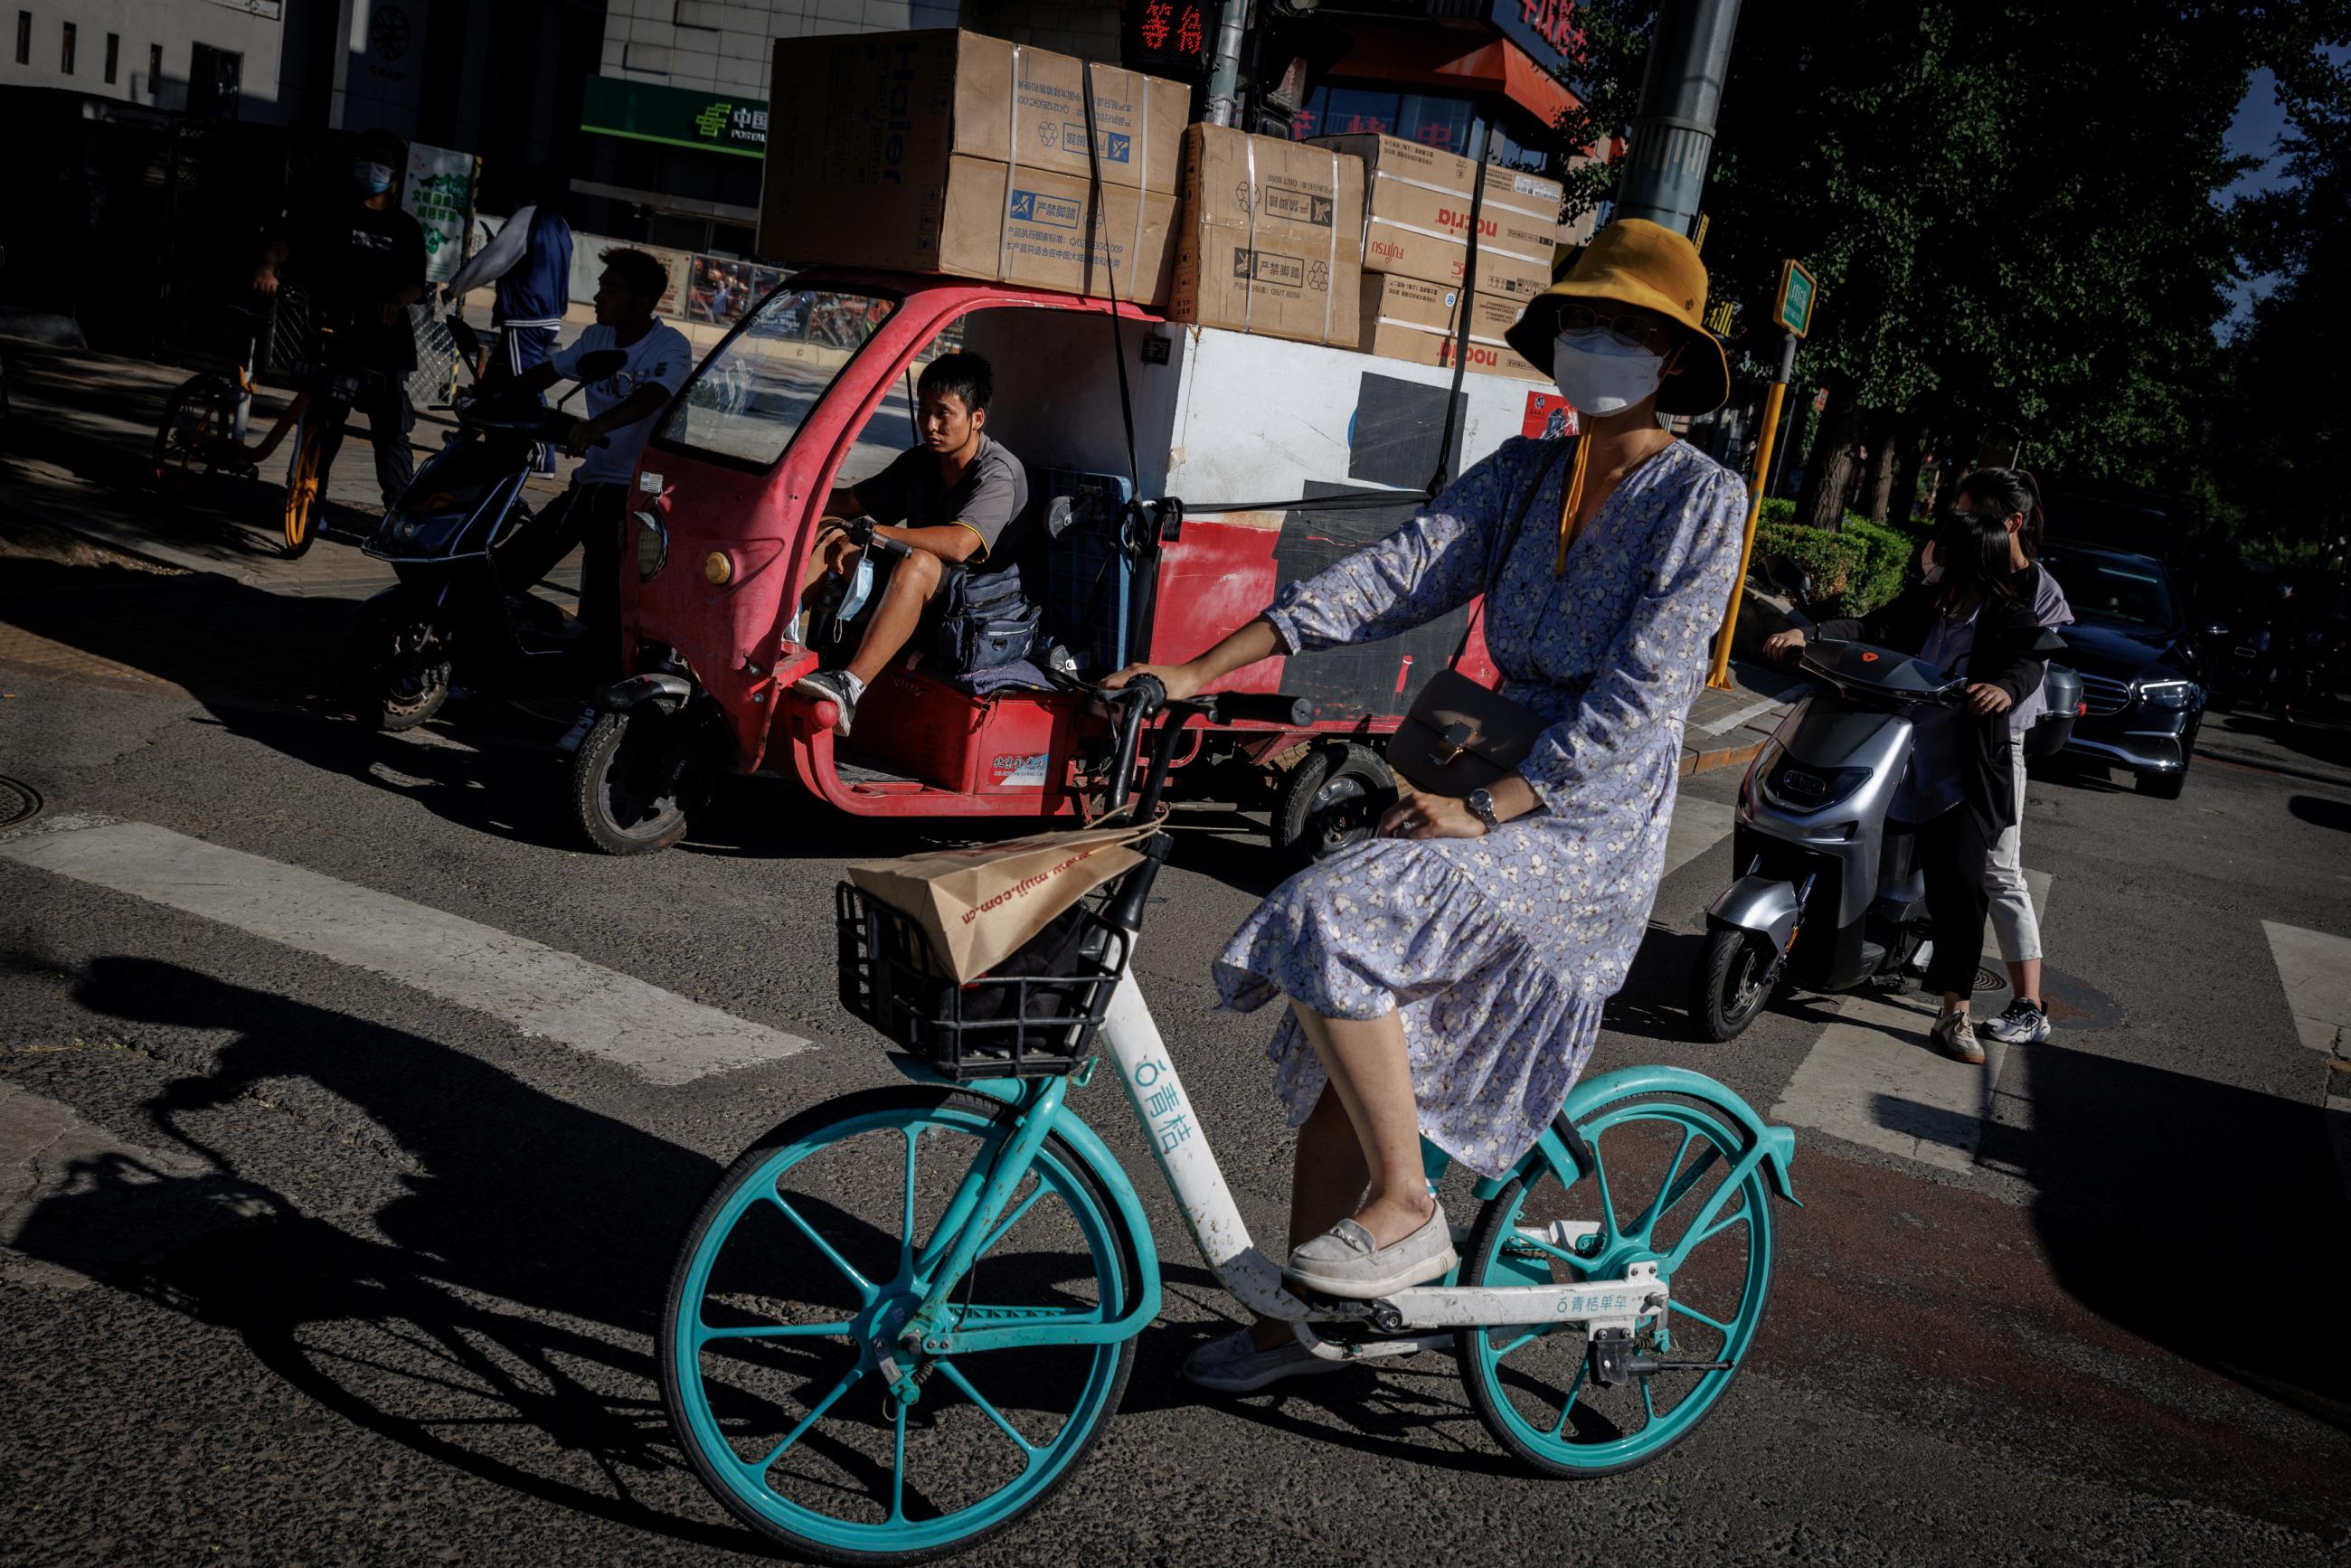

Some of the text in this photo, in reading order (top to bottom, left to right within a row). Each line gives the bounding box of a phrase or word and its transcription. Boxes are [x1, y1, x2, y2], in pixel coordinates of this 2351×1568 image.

[883, 42, 919, 186] Haier
[870, 118, 885, 186] home
[1065, 131, 1108, 152] 严脚踏
[1035, 201, 1077, 221] 严禁脚踏
[1268, 194, 1309, 215] 严禁脚踏
[1438, 208, 1497, 240] nocria
[1371, 239, 1404, 261] FUJITSU
[1259, 260, 1300, 279] 严禁脚踏
[1144, 1082, 1192, 1151] 青桔
[1572, 1295, 1628, 1313] 青桔单车
